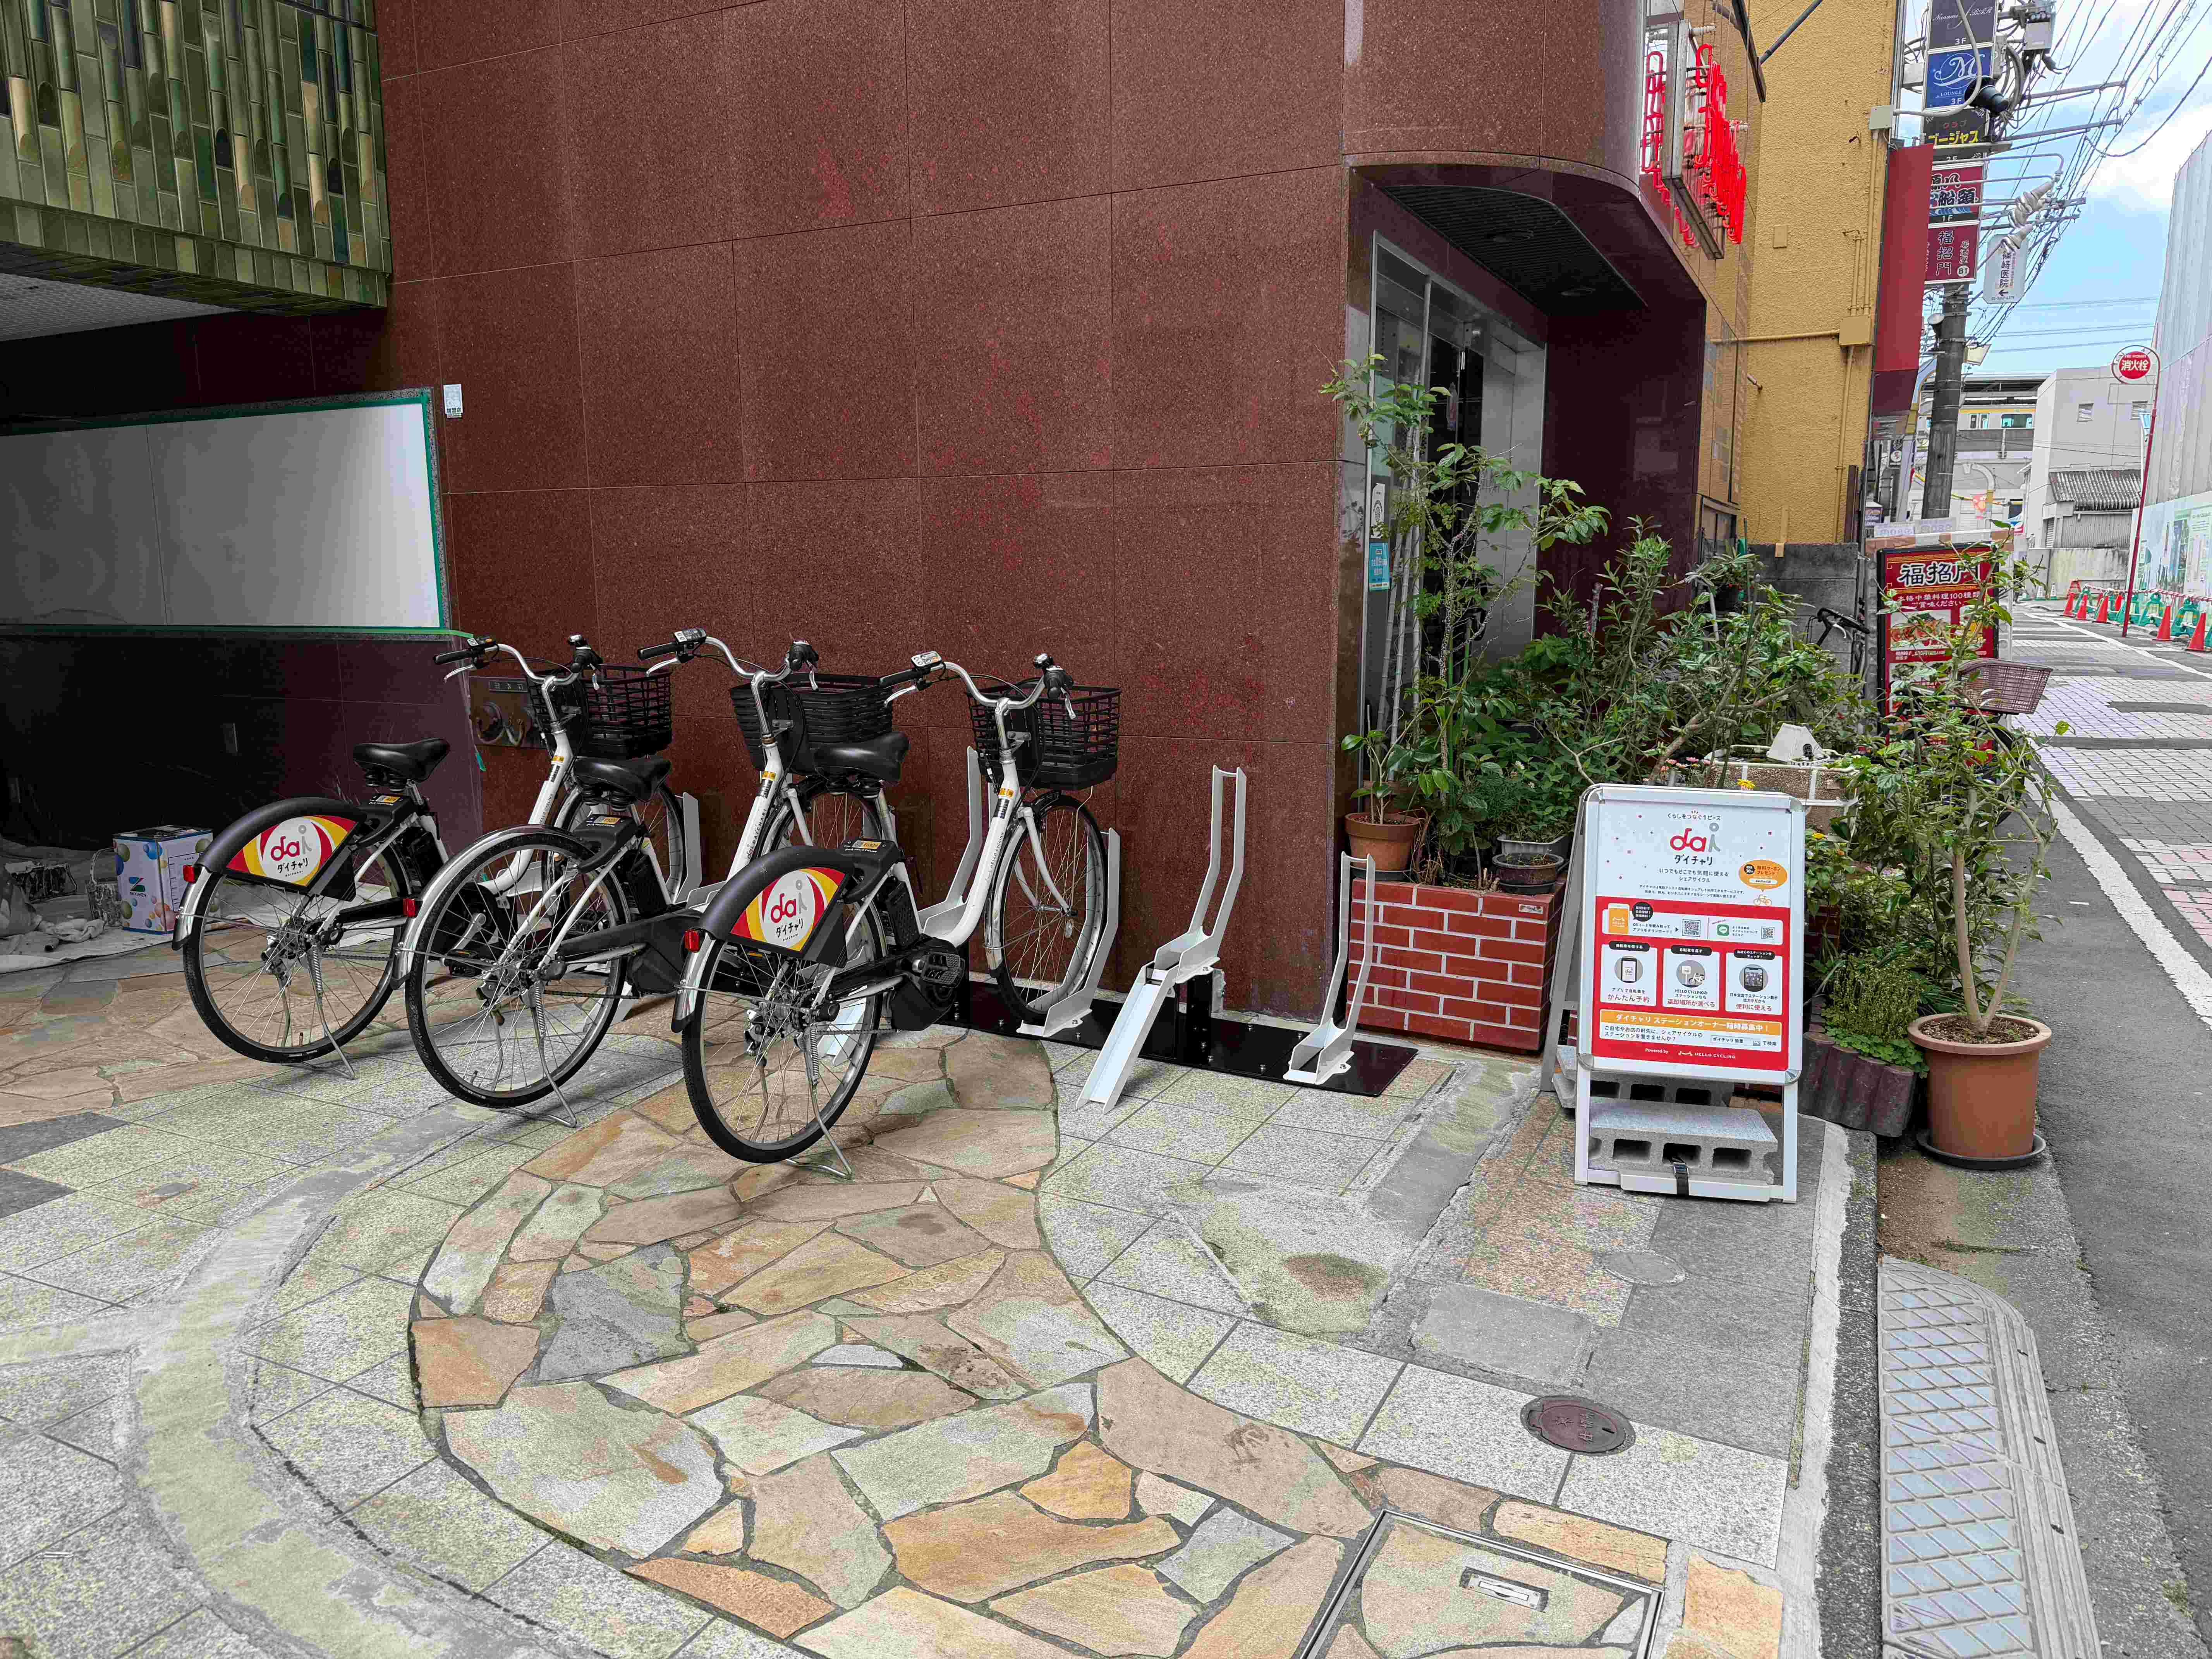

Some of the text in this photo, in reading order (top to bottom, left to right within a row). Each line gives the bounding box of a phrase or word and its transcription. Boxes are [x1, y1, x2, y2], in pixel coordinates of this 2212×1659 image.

[1936, 230, 1954, 276] 福招門
[1960, 240, 1969, 264] 居酒屋
[2121, 359, 2149, 371] 消火栓
[1667, 812, 1721, 821] くらしをつなぐ1ピース
[752, 808, 767, 844] DAICHARI
[271, 825, 313, 861] dai
[1670, 823, 1721, 852] dai
[277, 858, 308, 874] ダイチャリ
[1674, 854, 1713, 866] ダイチャリ
[1659, 868, 1729, 877] いつでもどこでも気軽に使える
[771, 879, 807, 923] dai
[776, 918, 804, 938] ダイチャリ
[1608, 994, 1650, 1003] かんたん予約
[1667, 998, 1715, 1007] 返却場所が選べる
[1616, 1014, 1651, 1023] ダイチャリ
[1605, 1031, 1676, 1041] ステーションを置きませんか？
